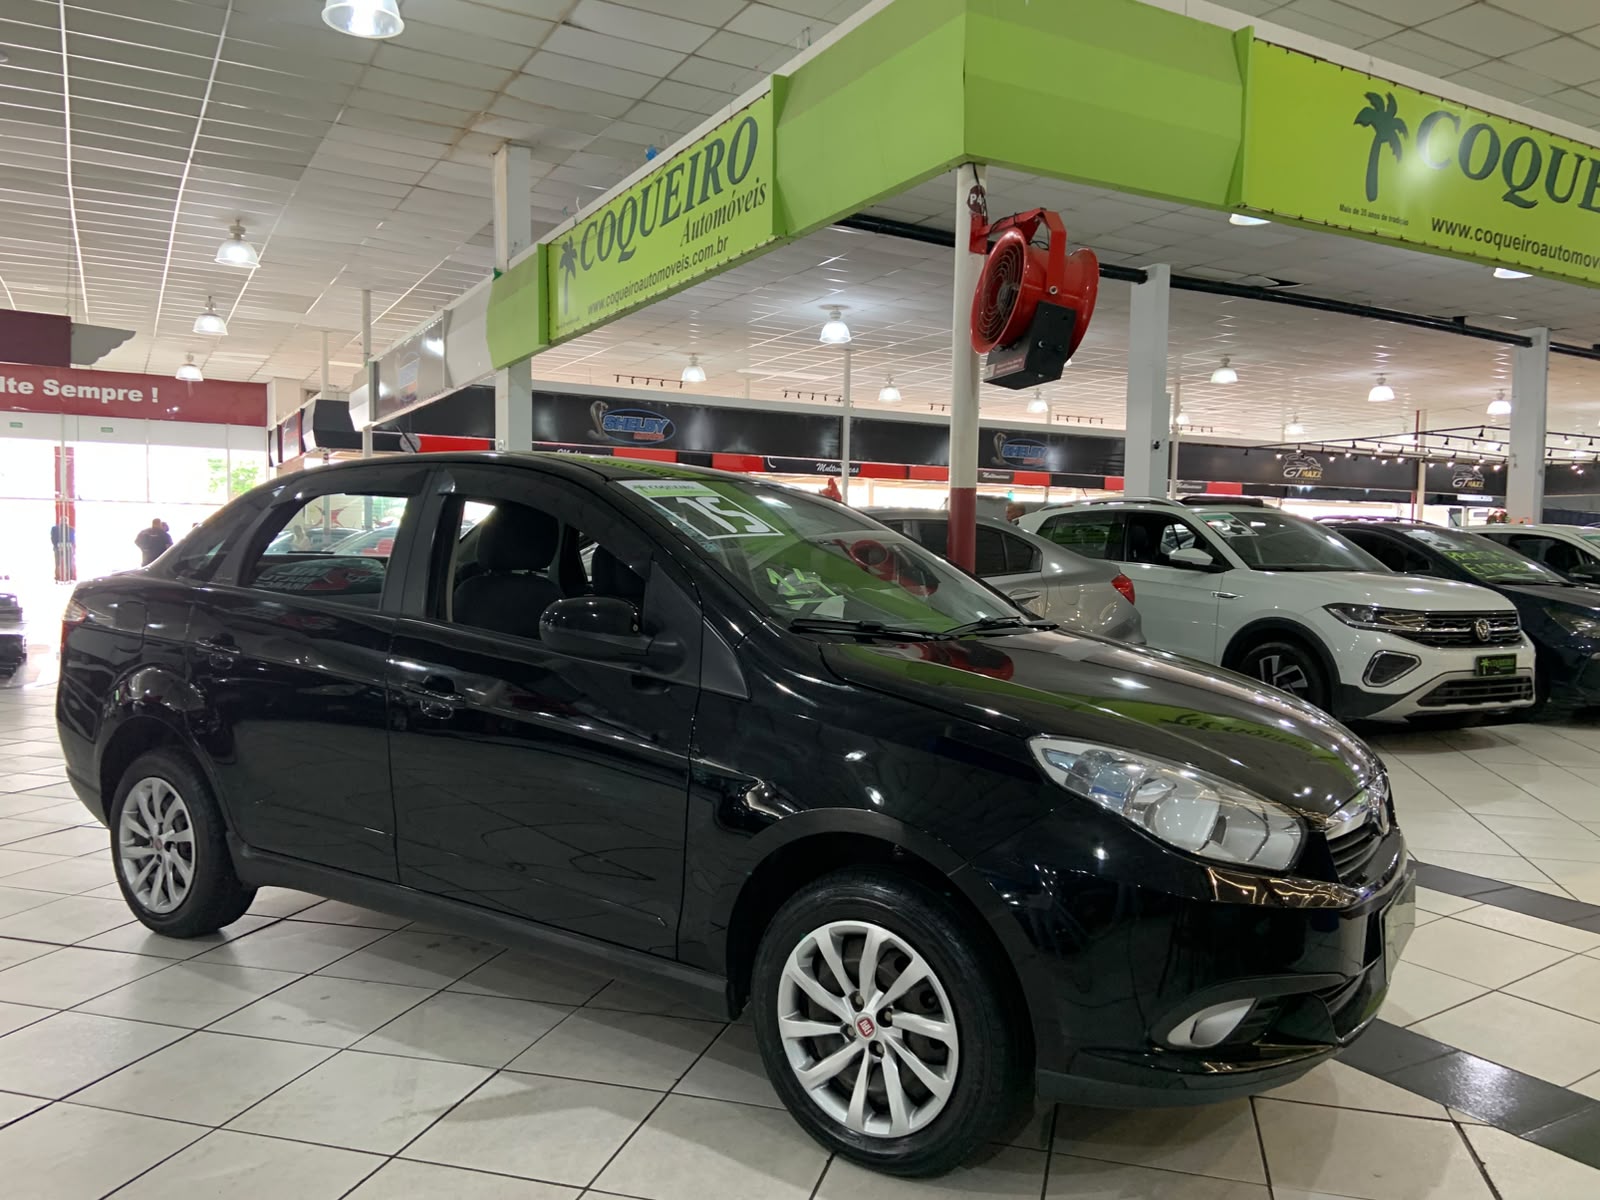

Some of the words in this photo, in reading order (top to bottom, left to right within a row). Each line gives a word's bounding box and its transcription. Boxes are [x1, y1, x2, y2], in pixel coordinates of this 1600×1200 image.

[1416, 110, 1600, 213] COQUE
[580, 116, 758, 271] COQUEIRO
[680, 177, 766, 247] Automóveis
[1431, 217, 1600, 269] www.coqueiroautomov
[587, 236, 729, 315] www.coqueiroautomoveis.com.br
[43, 379, 143, 403] Sempre
[602, 414, 671, 435] SHELBY
[676, 497, 770, 534] 15
